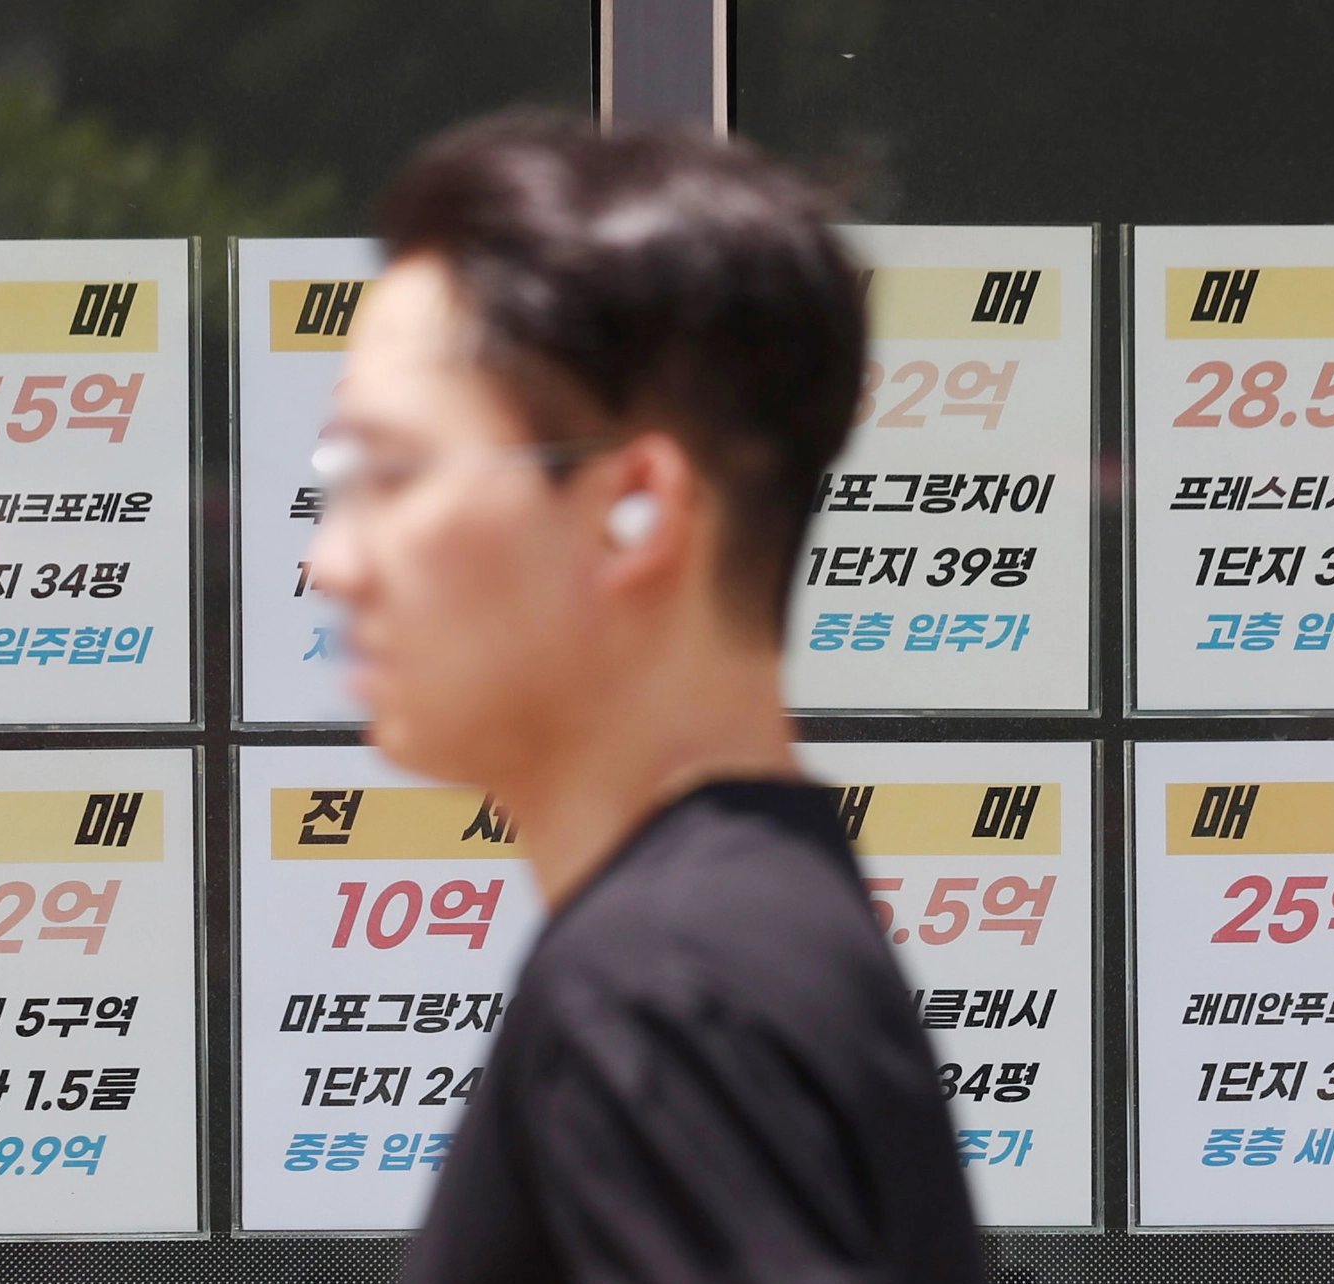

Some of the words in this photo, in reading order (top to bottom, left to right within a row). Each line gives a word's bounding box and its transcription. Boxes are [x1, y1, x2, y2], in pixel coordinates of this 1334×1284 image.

[70, 284, 137, 337] 매
[295, 282, 364, 336] 매
[971, 270, 1042, 325] 매
[1191, 270, 1259, 323] 매
[31, 563, 130, 599] 34평
[807, 547, 918, 587] 1단지
[926, 547, 1037, 587] 39평
[1196, 546, 1306, 586] 1단지
[809, 612, 894, 651] 중층
[904, 614, 1031, 652] 입주가
[1196, 612, 1283, 650] 고층
[75, 793, 143, 846] 매
[298, 790, 364, 844] 전
[971, 785, 1041, 839] 매
[1192, 785, 1259, 839] 매
[331, 879, 505, 949] 10억
[857, 875, 1057, 945] 5.5억
[16, 996, 138, 1037] 5구역
[279, 993, 504, 1033] 마포그랑자
[912, 989, 1057, 1029] 클래시
[25, 1068, 140, 1111] 1.5룸
[301, 1066, 411, 1106] 1단지
[418, 1067, 485, 1105] 24
[1198, 1061, 1308, 1101] 1단지
[283, 1132, 368, 1171] 중층
[378, 1133, 459, 1171] 입주
[956, 1129, 1033, 1167] 주가
[1202, 1127, 1286, 1166] 중층
